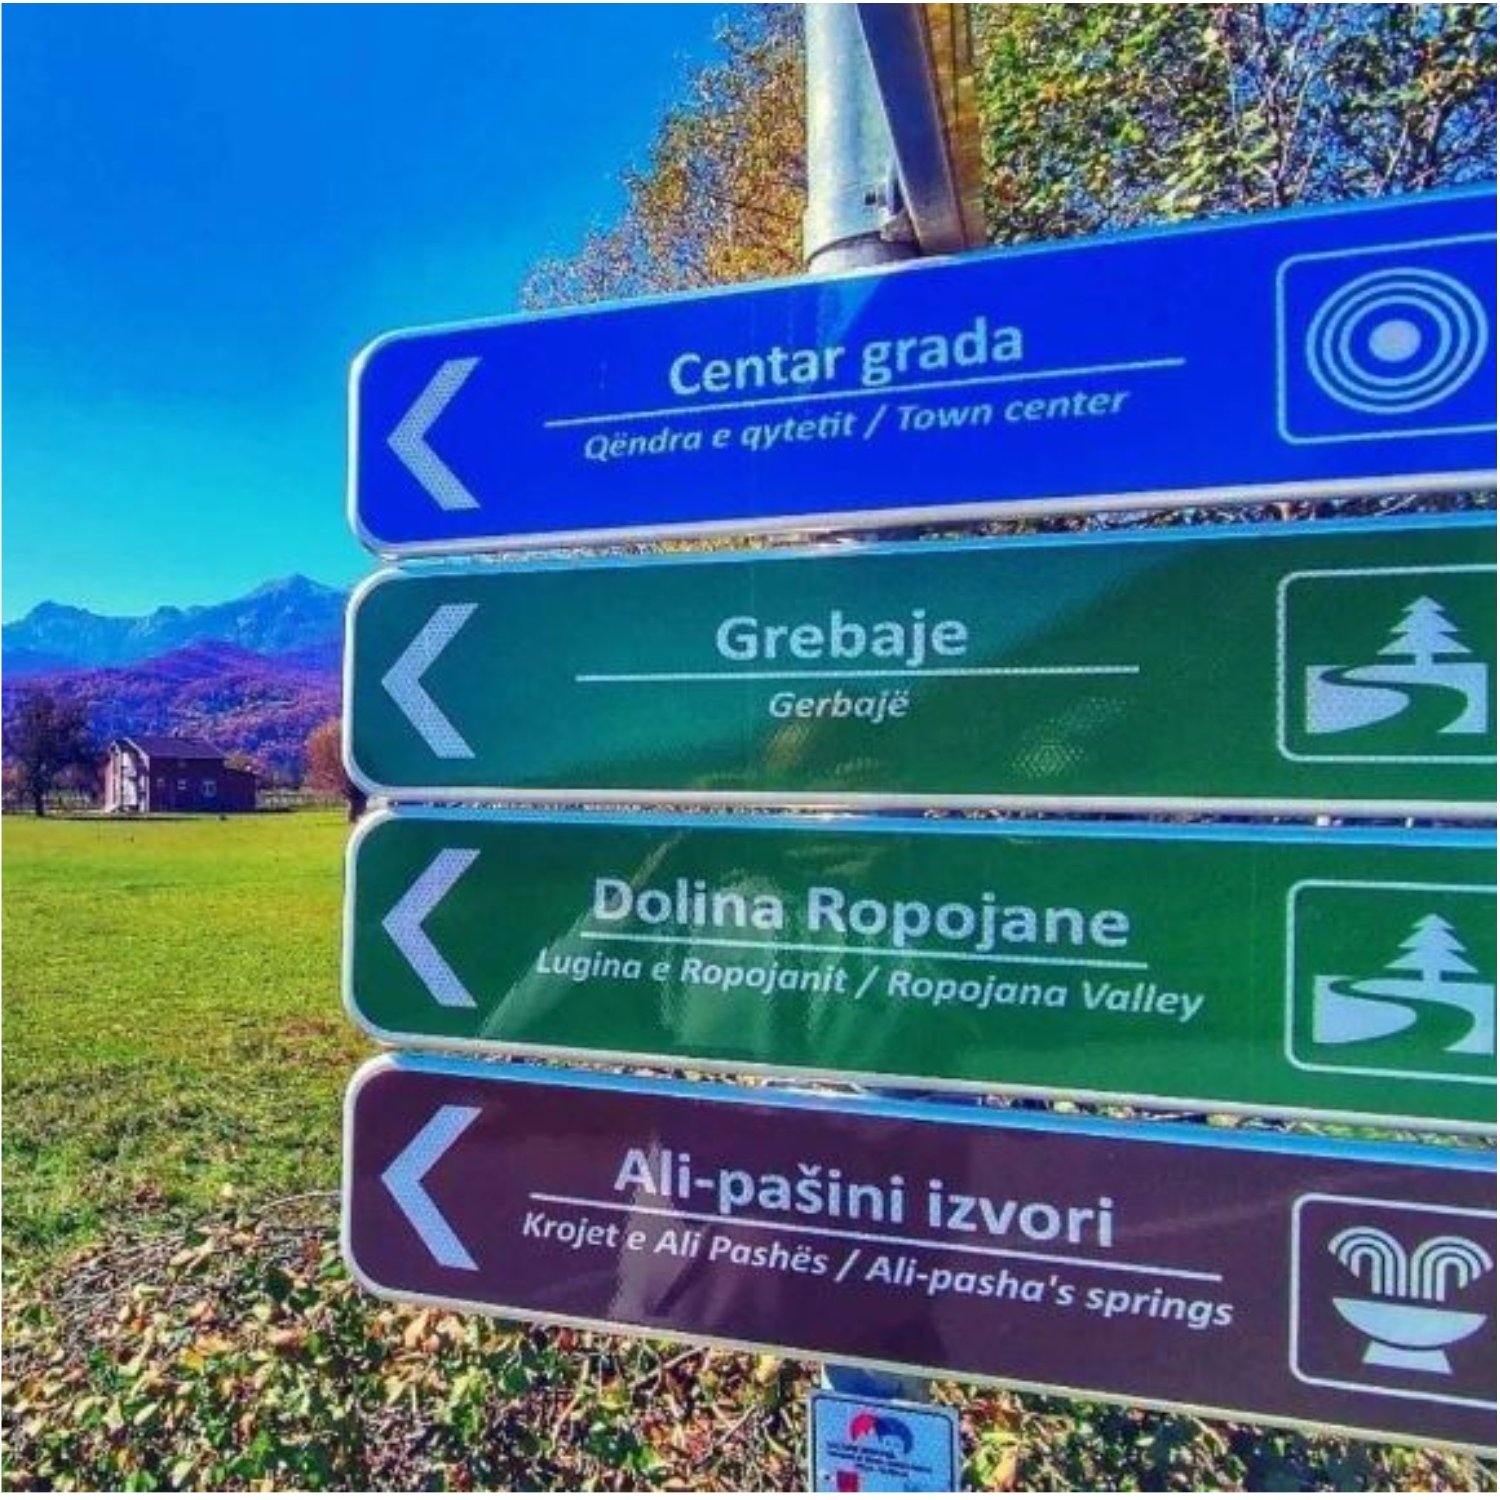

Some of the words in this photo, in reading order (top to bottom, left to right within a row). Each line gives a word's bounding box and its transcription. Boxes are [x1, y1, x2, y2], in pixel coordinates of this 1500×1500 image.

[669, 341, 844, 397] Centar
[860, 316, 1023, 387] grada
[584, 426, 701, 461] Qëndra
[712, 428, 729, 449] e
[741, 410, 856, 451] qytetit
[864, 405, 886, 441] /
[899, 402, 991, 431] Town
[1004, 388, 1130, 422] center
[715, 609, 969, 666] Grebaje
[768, 691, 909, 723] Gerbajë
[593, 877, 784, 930] Dolina
[807, 886, 1130, 953] Ropojane
[536, 948, 641, 980] Lugina
[651, 961, 670, 981] e
[680, 958, 848, 995] Ropojanit
[855, 965, 878, 998] /
[888, 969, 1067, 1008] Ropojana
[1081, 980, 1203, 1022] Valley
[613, 1148, 904, 1223] Ali-pašini
[928, 1180, 1114, 1247] izvori
[522, 1211, 618, 1250] Krojet
[628, 1231, 645, 1251] e
[653, 1229, 701, 1258] Ali
[709, 1235, 827, 1275] Pashës
[836, 1249, 859, 1283] /
[866, 1256, 1074, 1306] Ali-pasha's
[1086, 1284, 1233, 1330] springs
